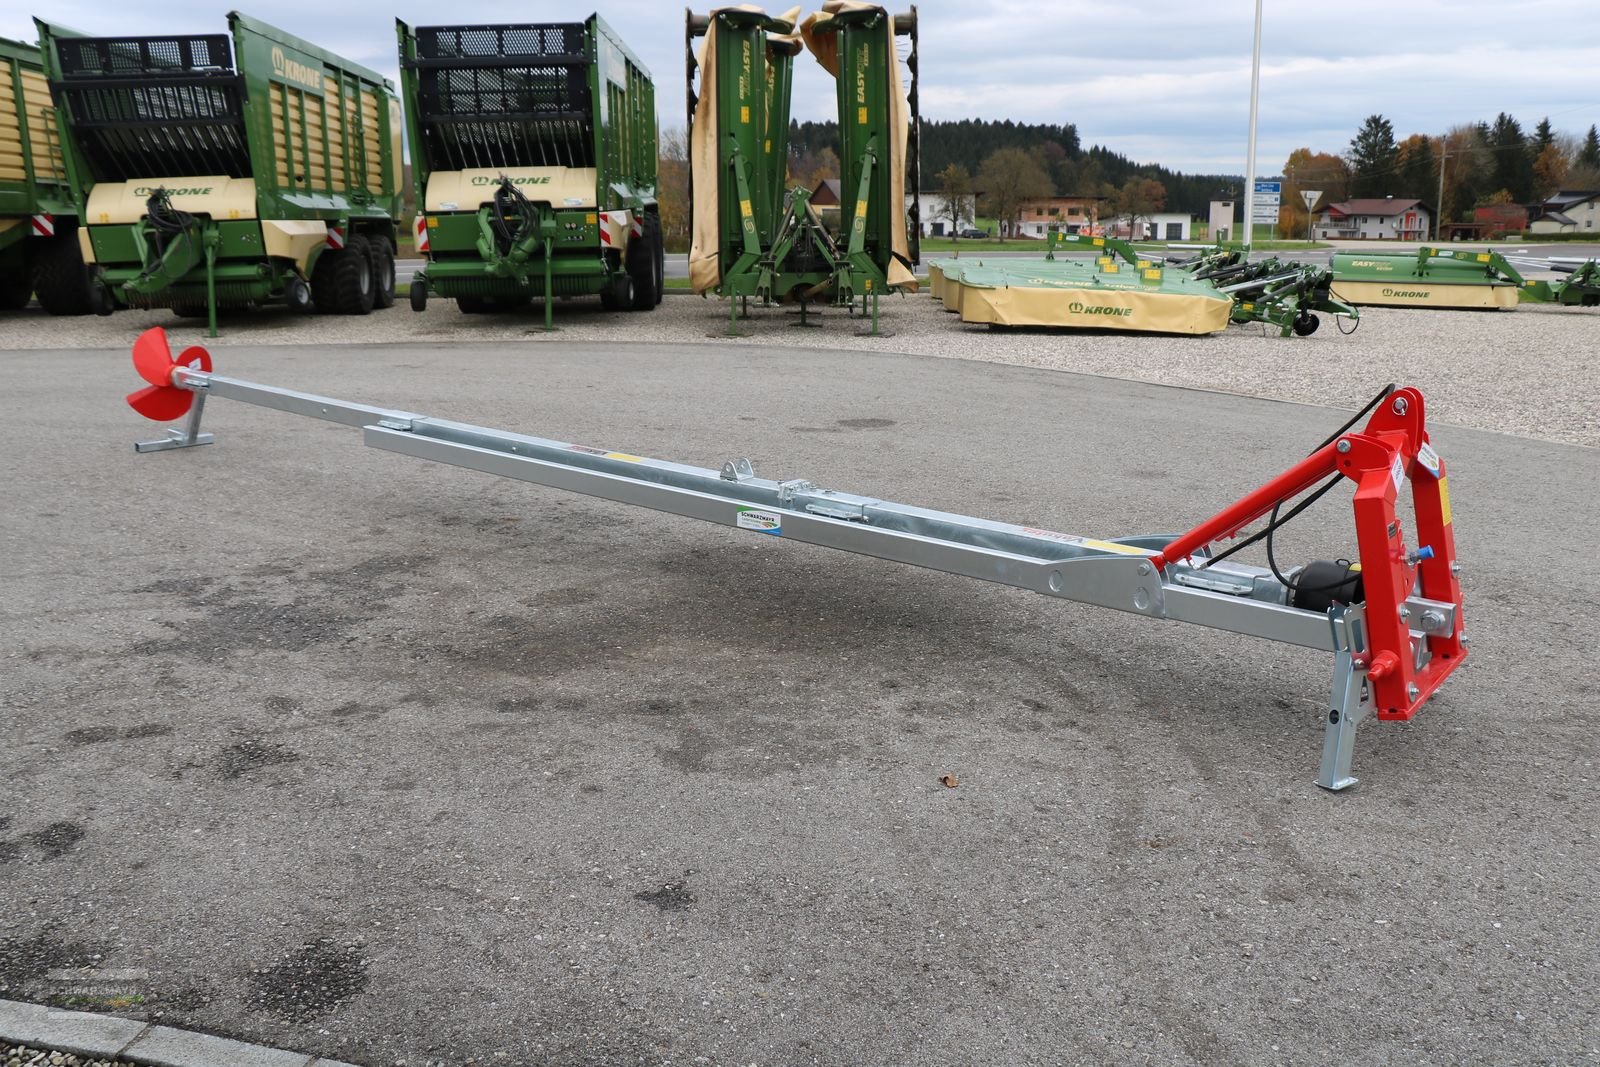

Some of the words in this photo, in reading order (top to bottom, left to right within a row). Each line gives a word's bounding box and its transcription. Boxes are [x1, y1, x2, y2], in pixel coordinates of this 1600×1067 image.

[284, 58, 321, 89] KRONE
[490, 176, 551, 186] KONE
[163, 187, 213, 196] RONE
[1084, 305, 1133, 317] KRONE
